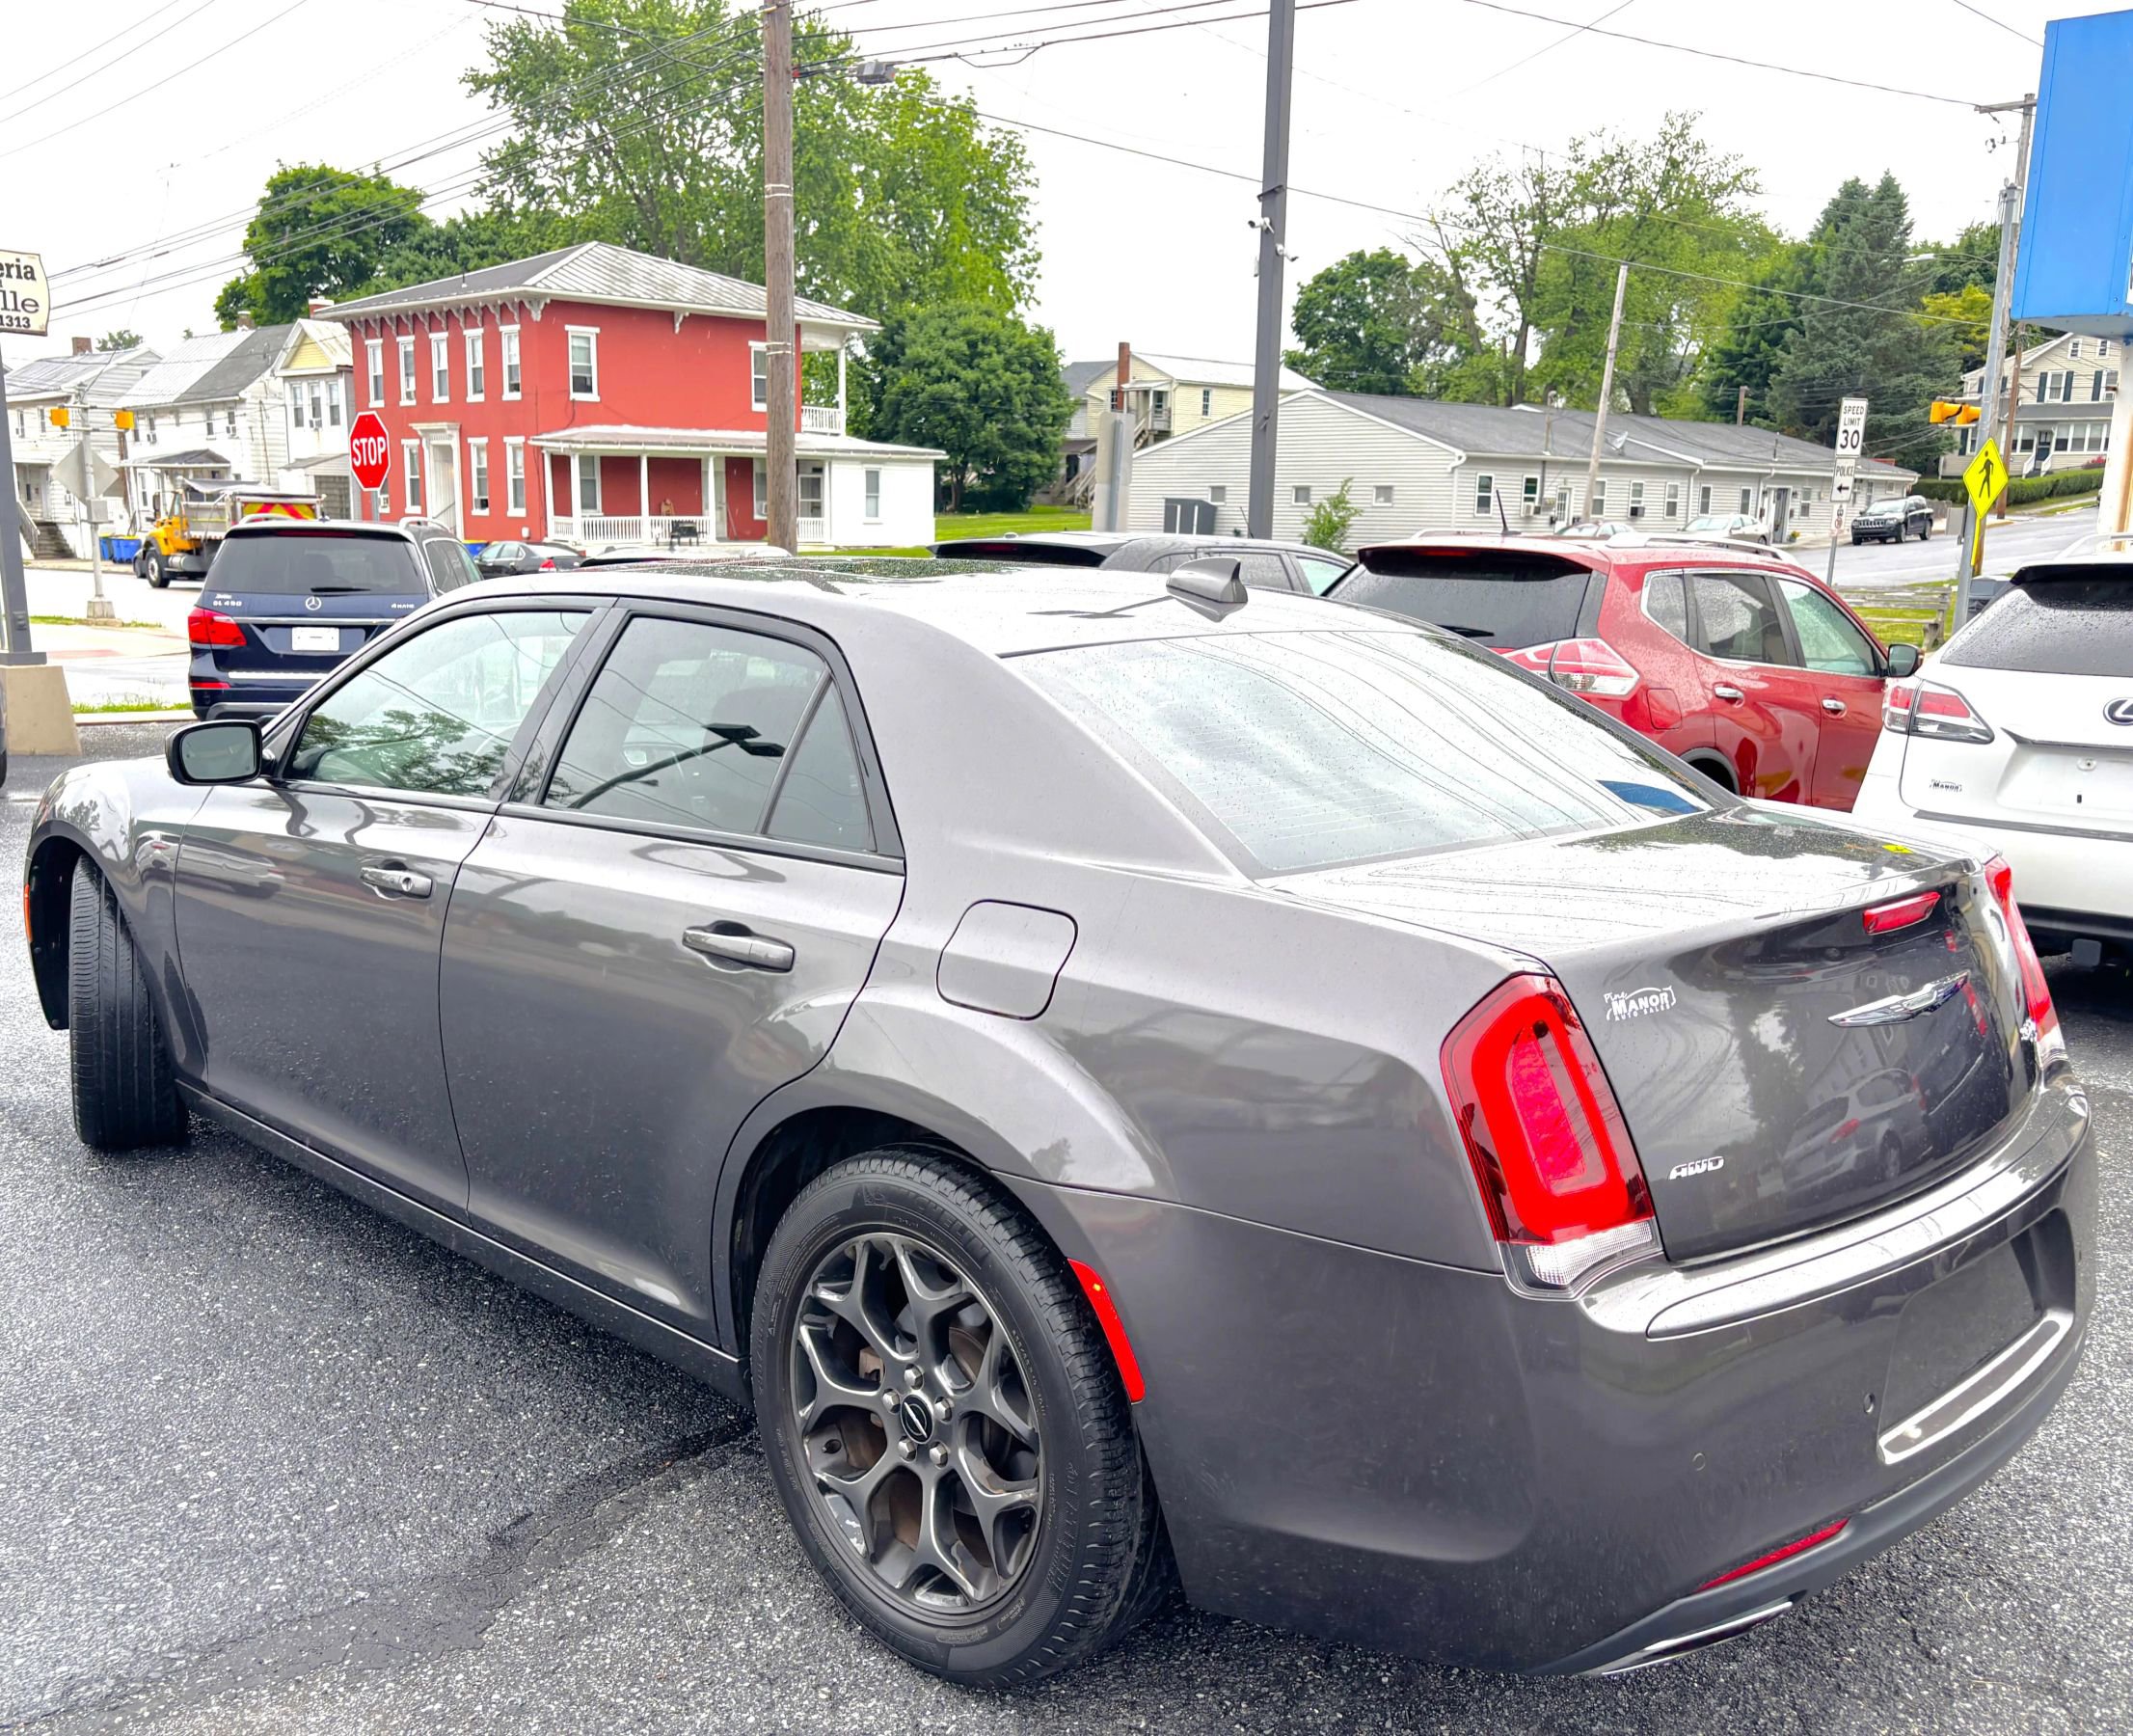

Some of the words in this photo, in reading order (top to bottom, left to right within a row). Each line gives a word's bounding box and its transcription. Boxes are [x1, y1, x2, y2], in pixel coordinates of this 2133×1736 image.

[0, 289, 40, 313] lle
[1843, 405, 1865, 415] SPEED
[1843, 417, 1861, 426] LIMIT
[1839, 429, 1860, 449] 30
[352, 436, 387, 467] STOP
[1835, 465, 1854, 476] POLICE
[1604, 991, 1628, 1003] Pine
[1611, 992, 1670, 1016] MANOR
[1614, 1010, 1638, 1021] AUTO
[1669, 1155, 1724, 1180] AWD
